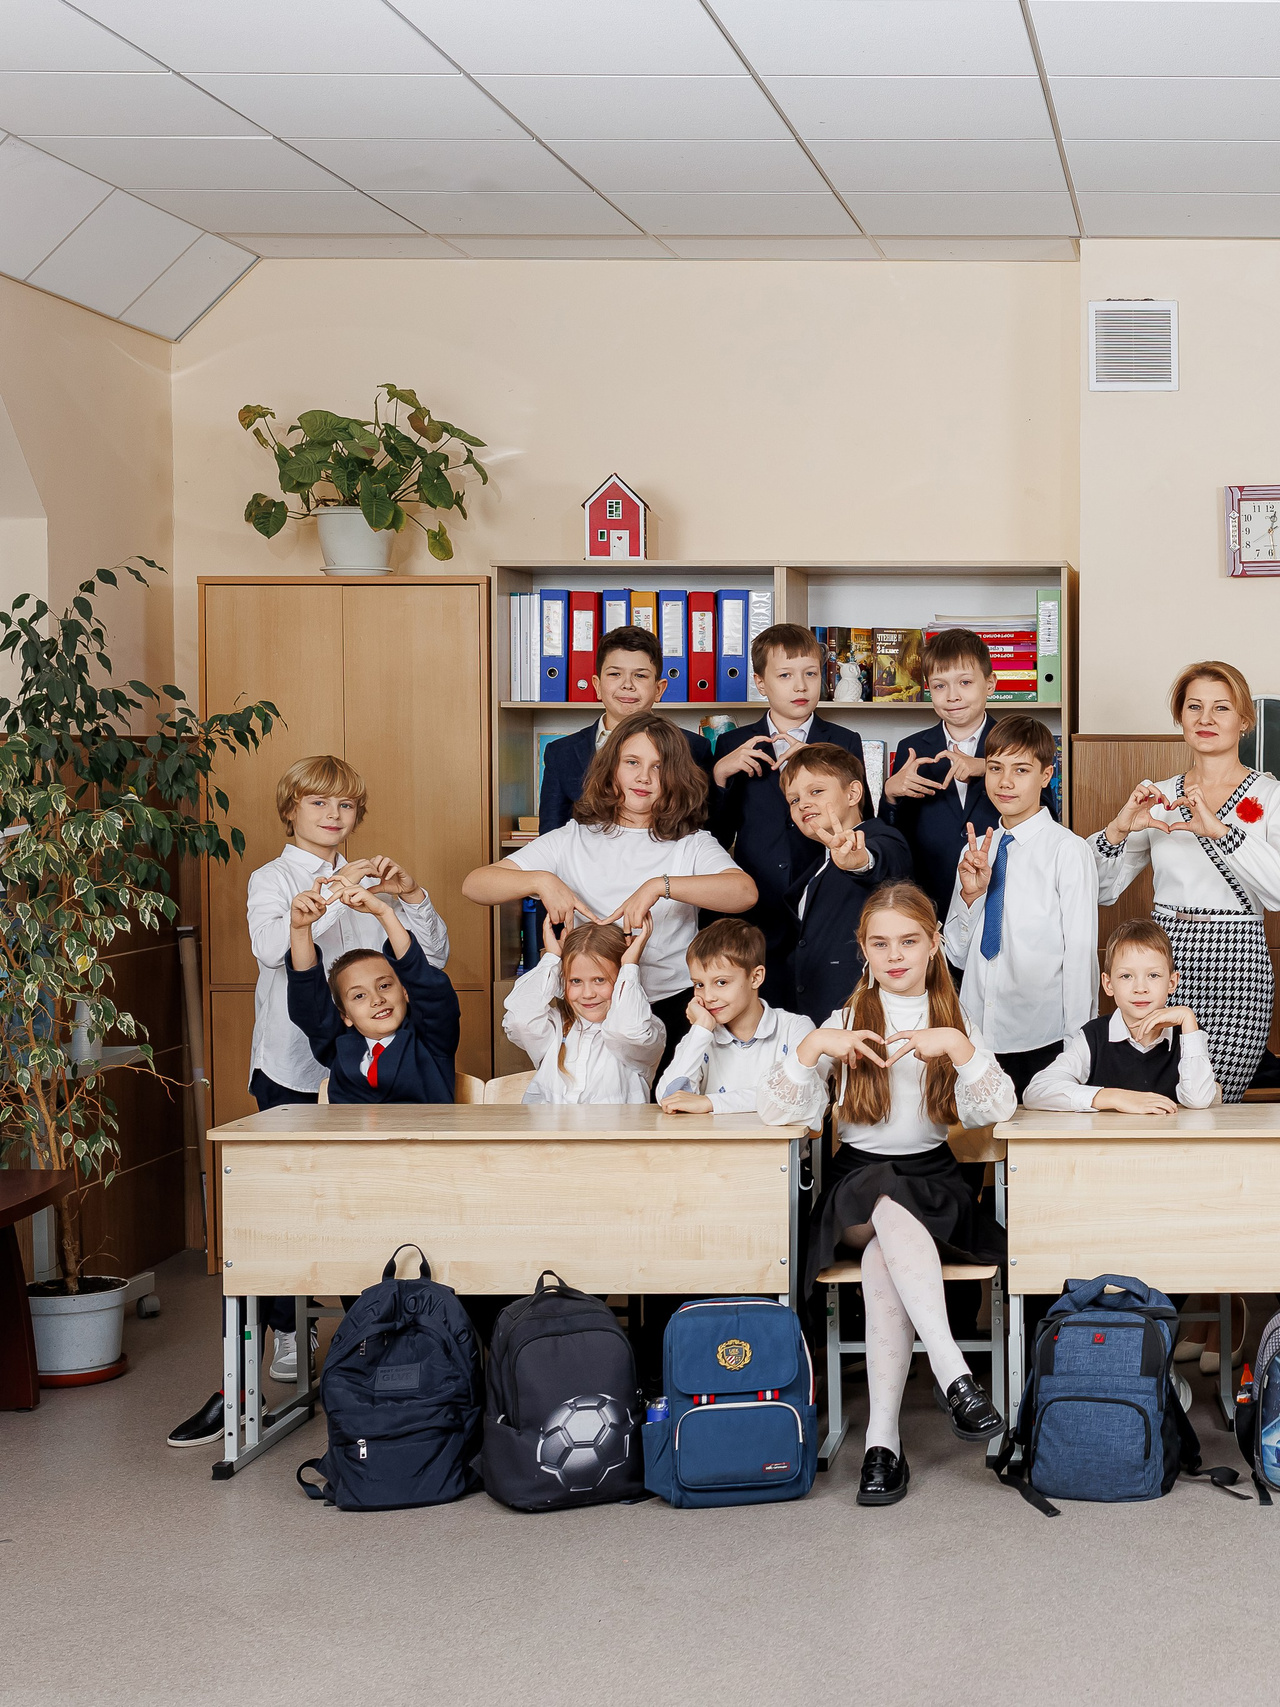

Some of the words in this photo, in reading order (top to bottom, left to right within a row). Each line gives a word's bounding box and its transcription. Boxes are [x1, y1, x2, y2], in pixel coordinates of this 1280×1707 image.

[1244, 514, 1252, 522] 10
[1245, 541, 1251, 549] 8
[1255, 549, 1260, 557] 7
